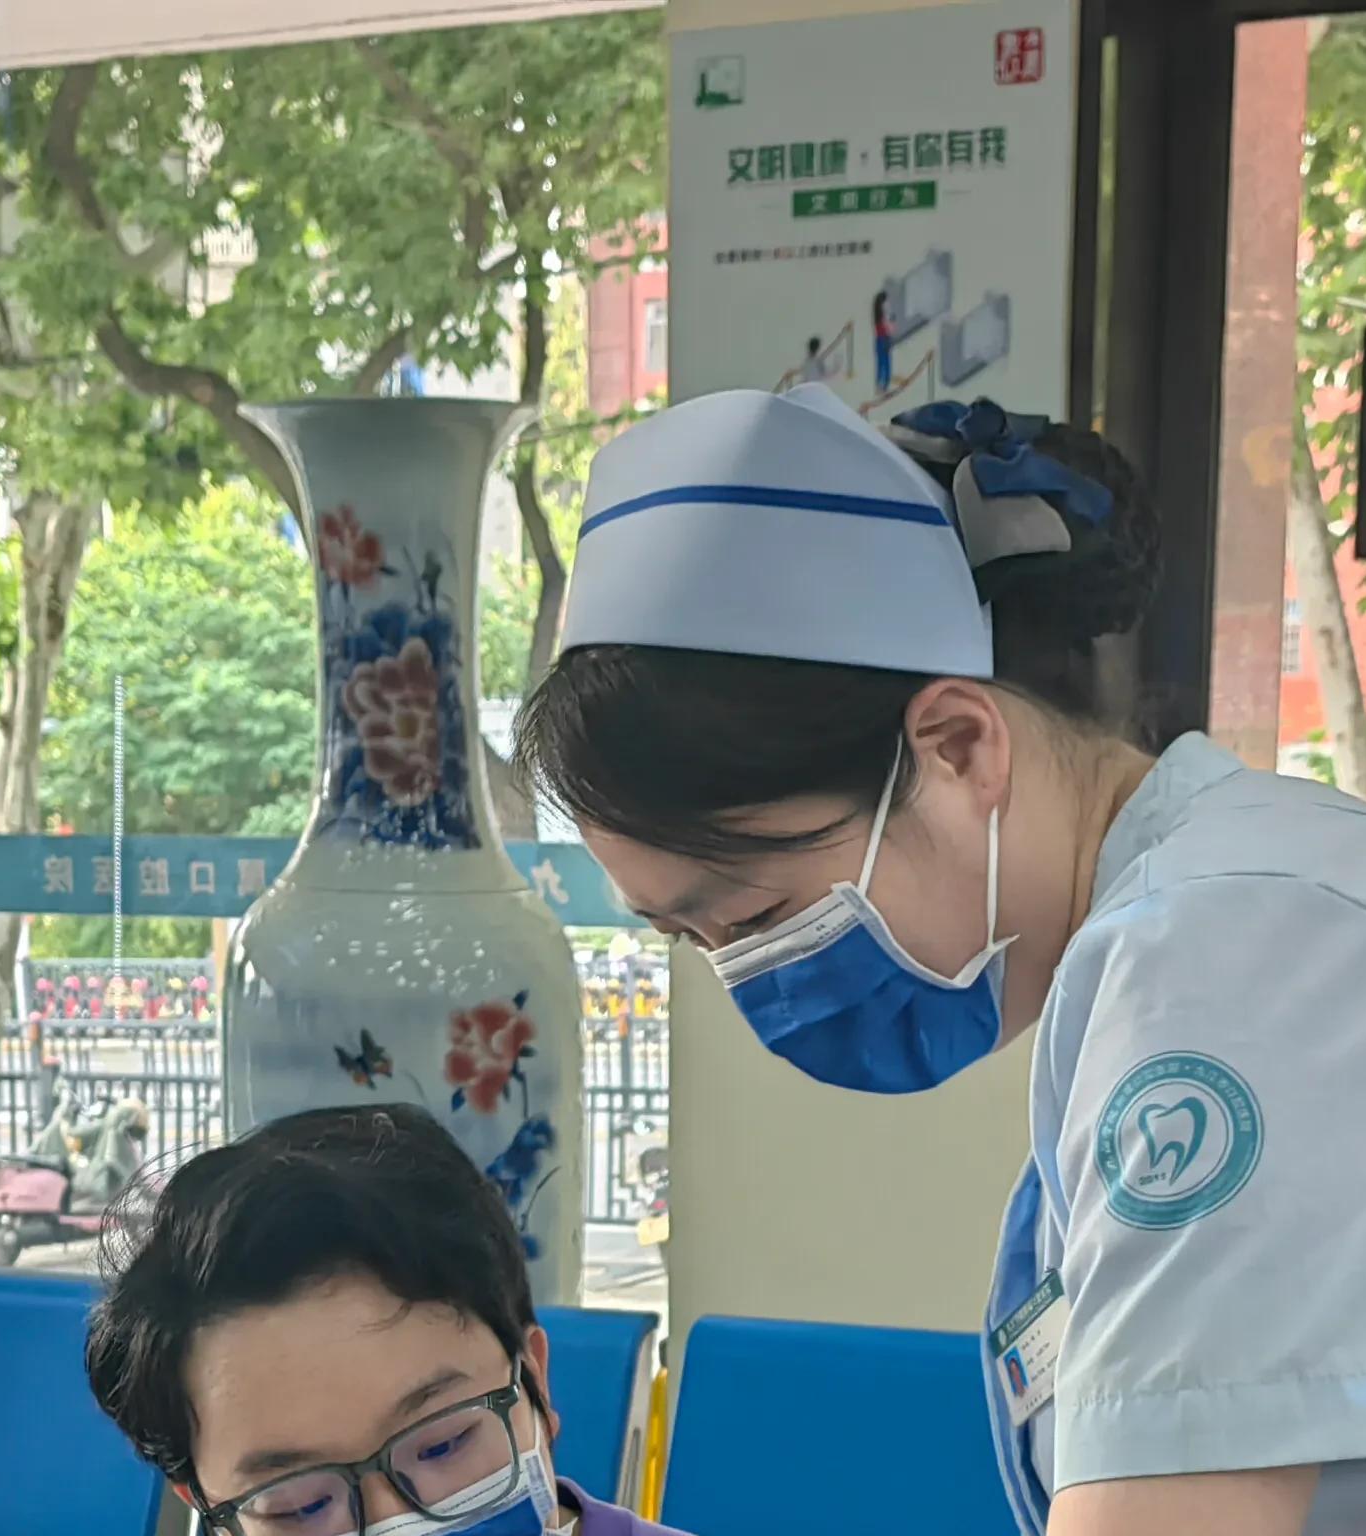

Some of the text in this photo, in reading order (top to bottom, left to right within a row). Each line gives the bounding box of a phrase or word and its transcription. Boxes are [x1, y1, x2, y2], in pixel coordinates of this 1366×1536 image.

[727, 127, 1008, 184] 文明健康·有你有我
